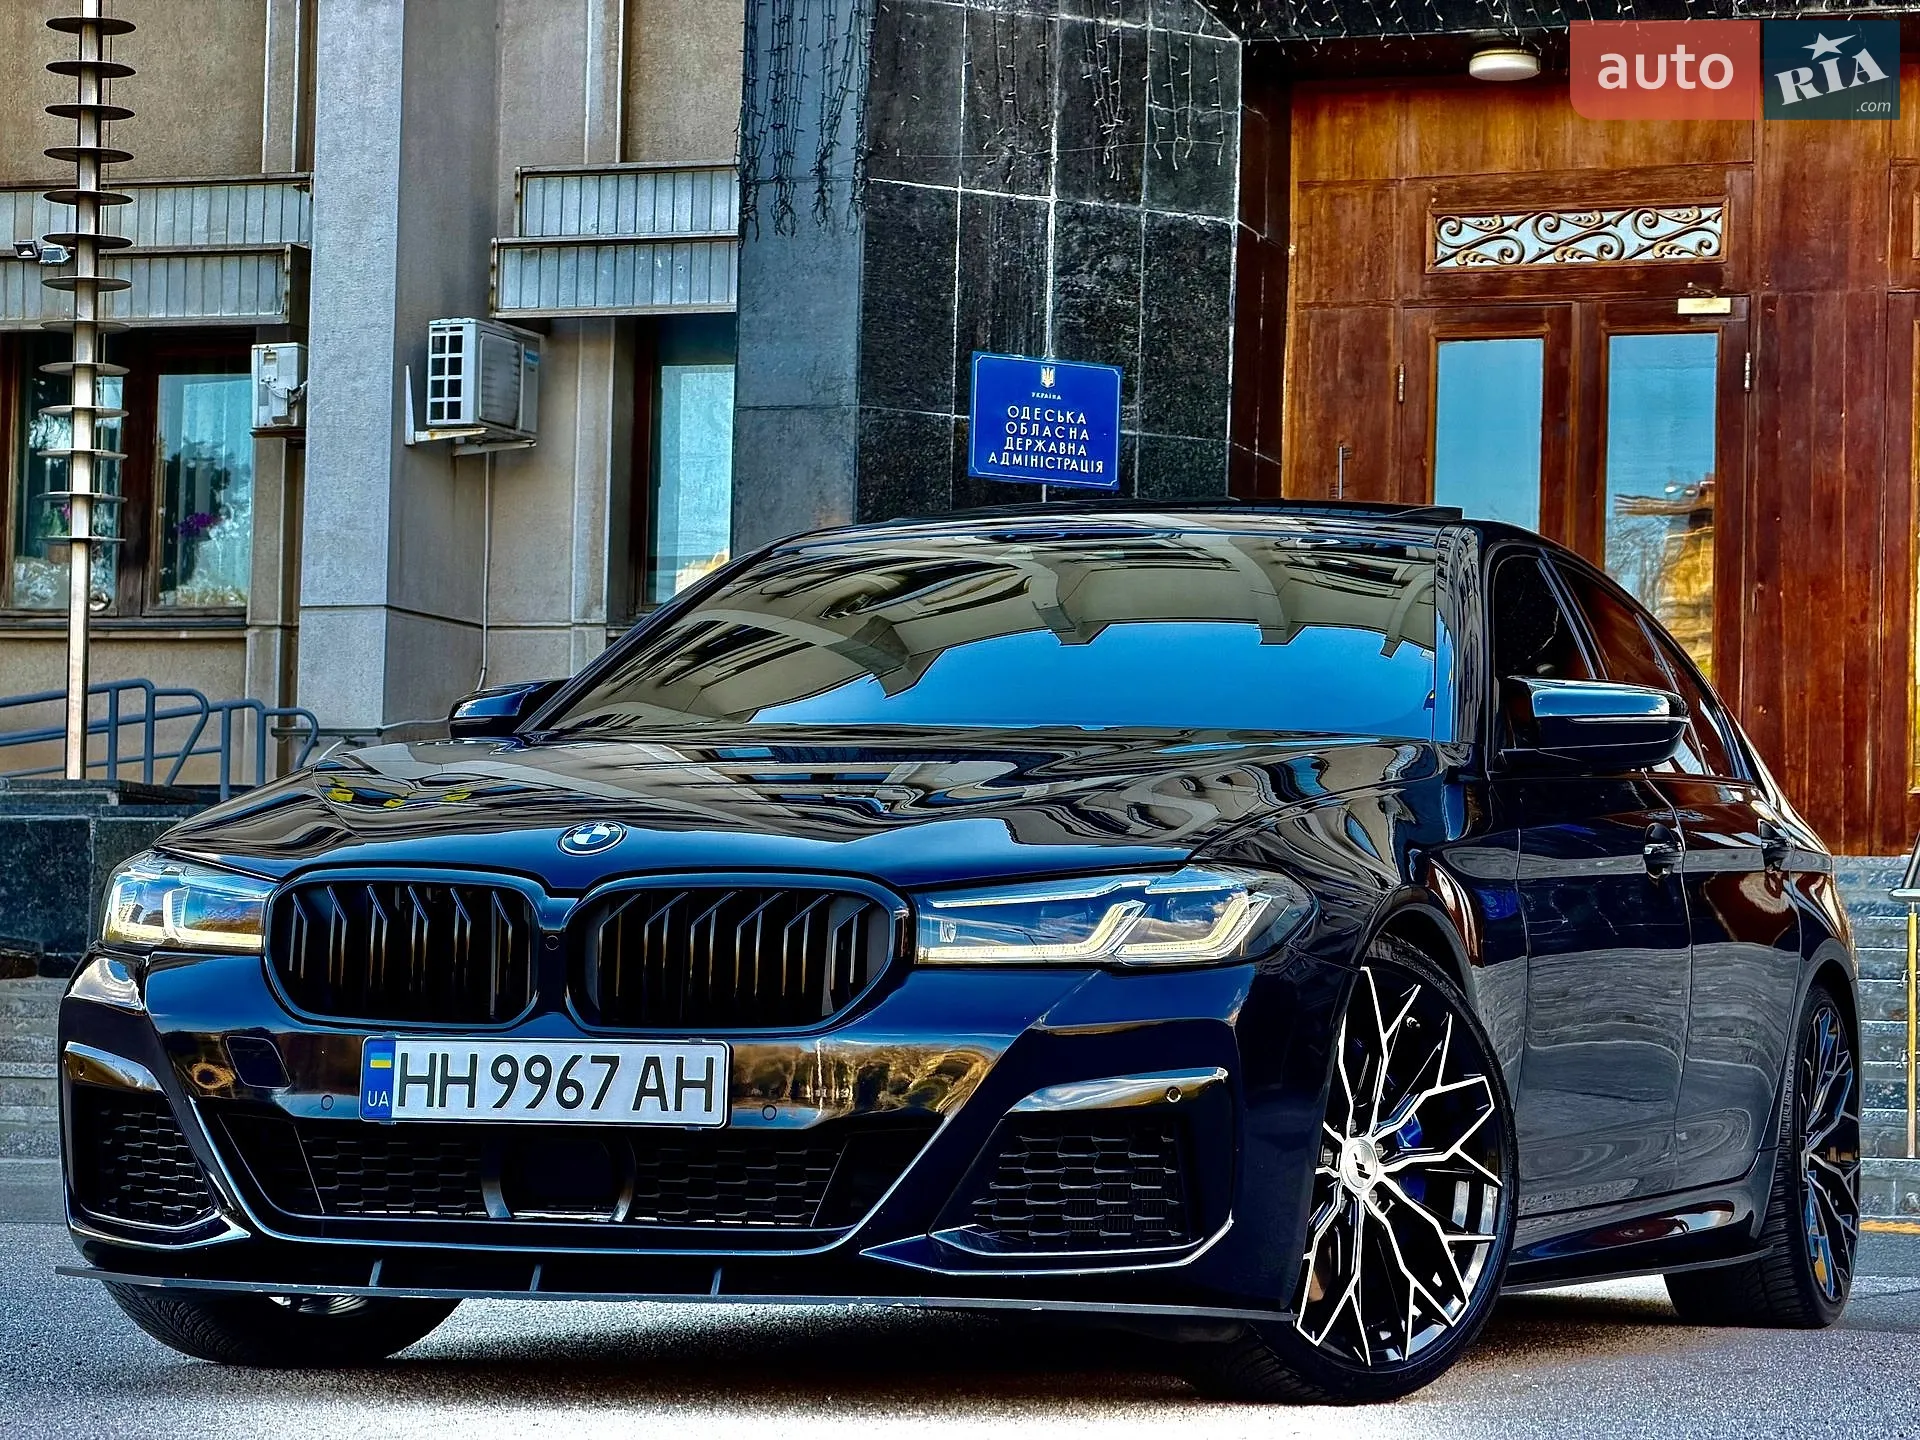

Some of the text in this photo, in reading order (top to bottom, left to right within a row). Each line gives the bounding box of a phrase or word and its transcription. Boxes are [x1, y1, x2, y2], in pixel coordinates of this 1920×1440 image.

[1031, 391, 1062, 400] УКРАЇНА
[1007, 405, 1087, 425] ОДЕСЬКА
[1005, 421, 1090, 441] ОБЛАСНА
[1004, 437, 1087, 457] ДЕРЖАВНА
[988, 451, 1104, 474] АДМІНІСТРАЦІЯ
[397, 1052, 716, 1113] HH 9967 AH
[367, 1090, 390, 1108] UA
